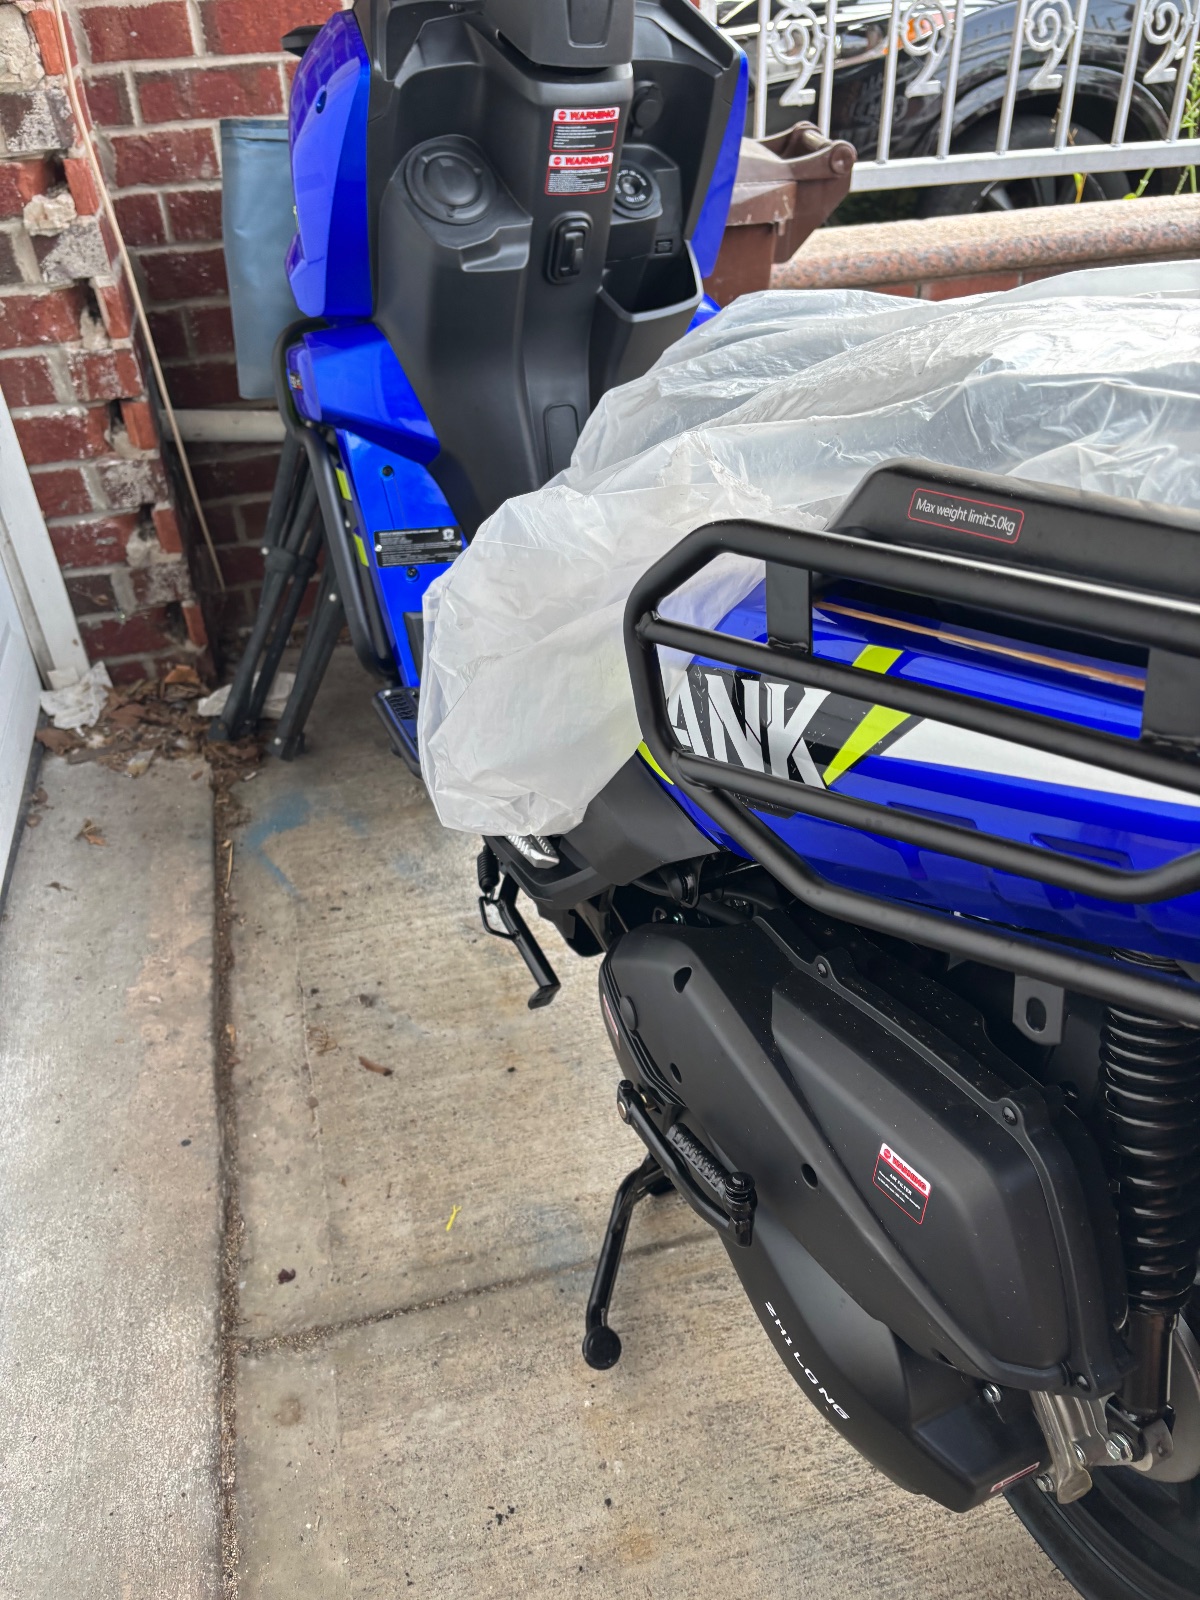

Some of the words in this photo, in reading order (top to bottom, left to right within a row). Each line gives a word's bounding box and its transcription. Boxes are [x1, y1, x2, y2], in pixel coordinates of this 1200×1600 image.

[569, 109, 616, 121] WARNING
[565, 154, 609, 166] WARNING
[915, 497, 936, 514] Max
[936, 504, 968, 523] weight
[892, 1155, 927, 1192] WARNING
